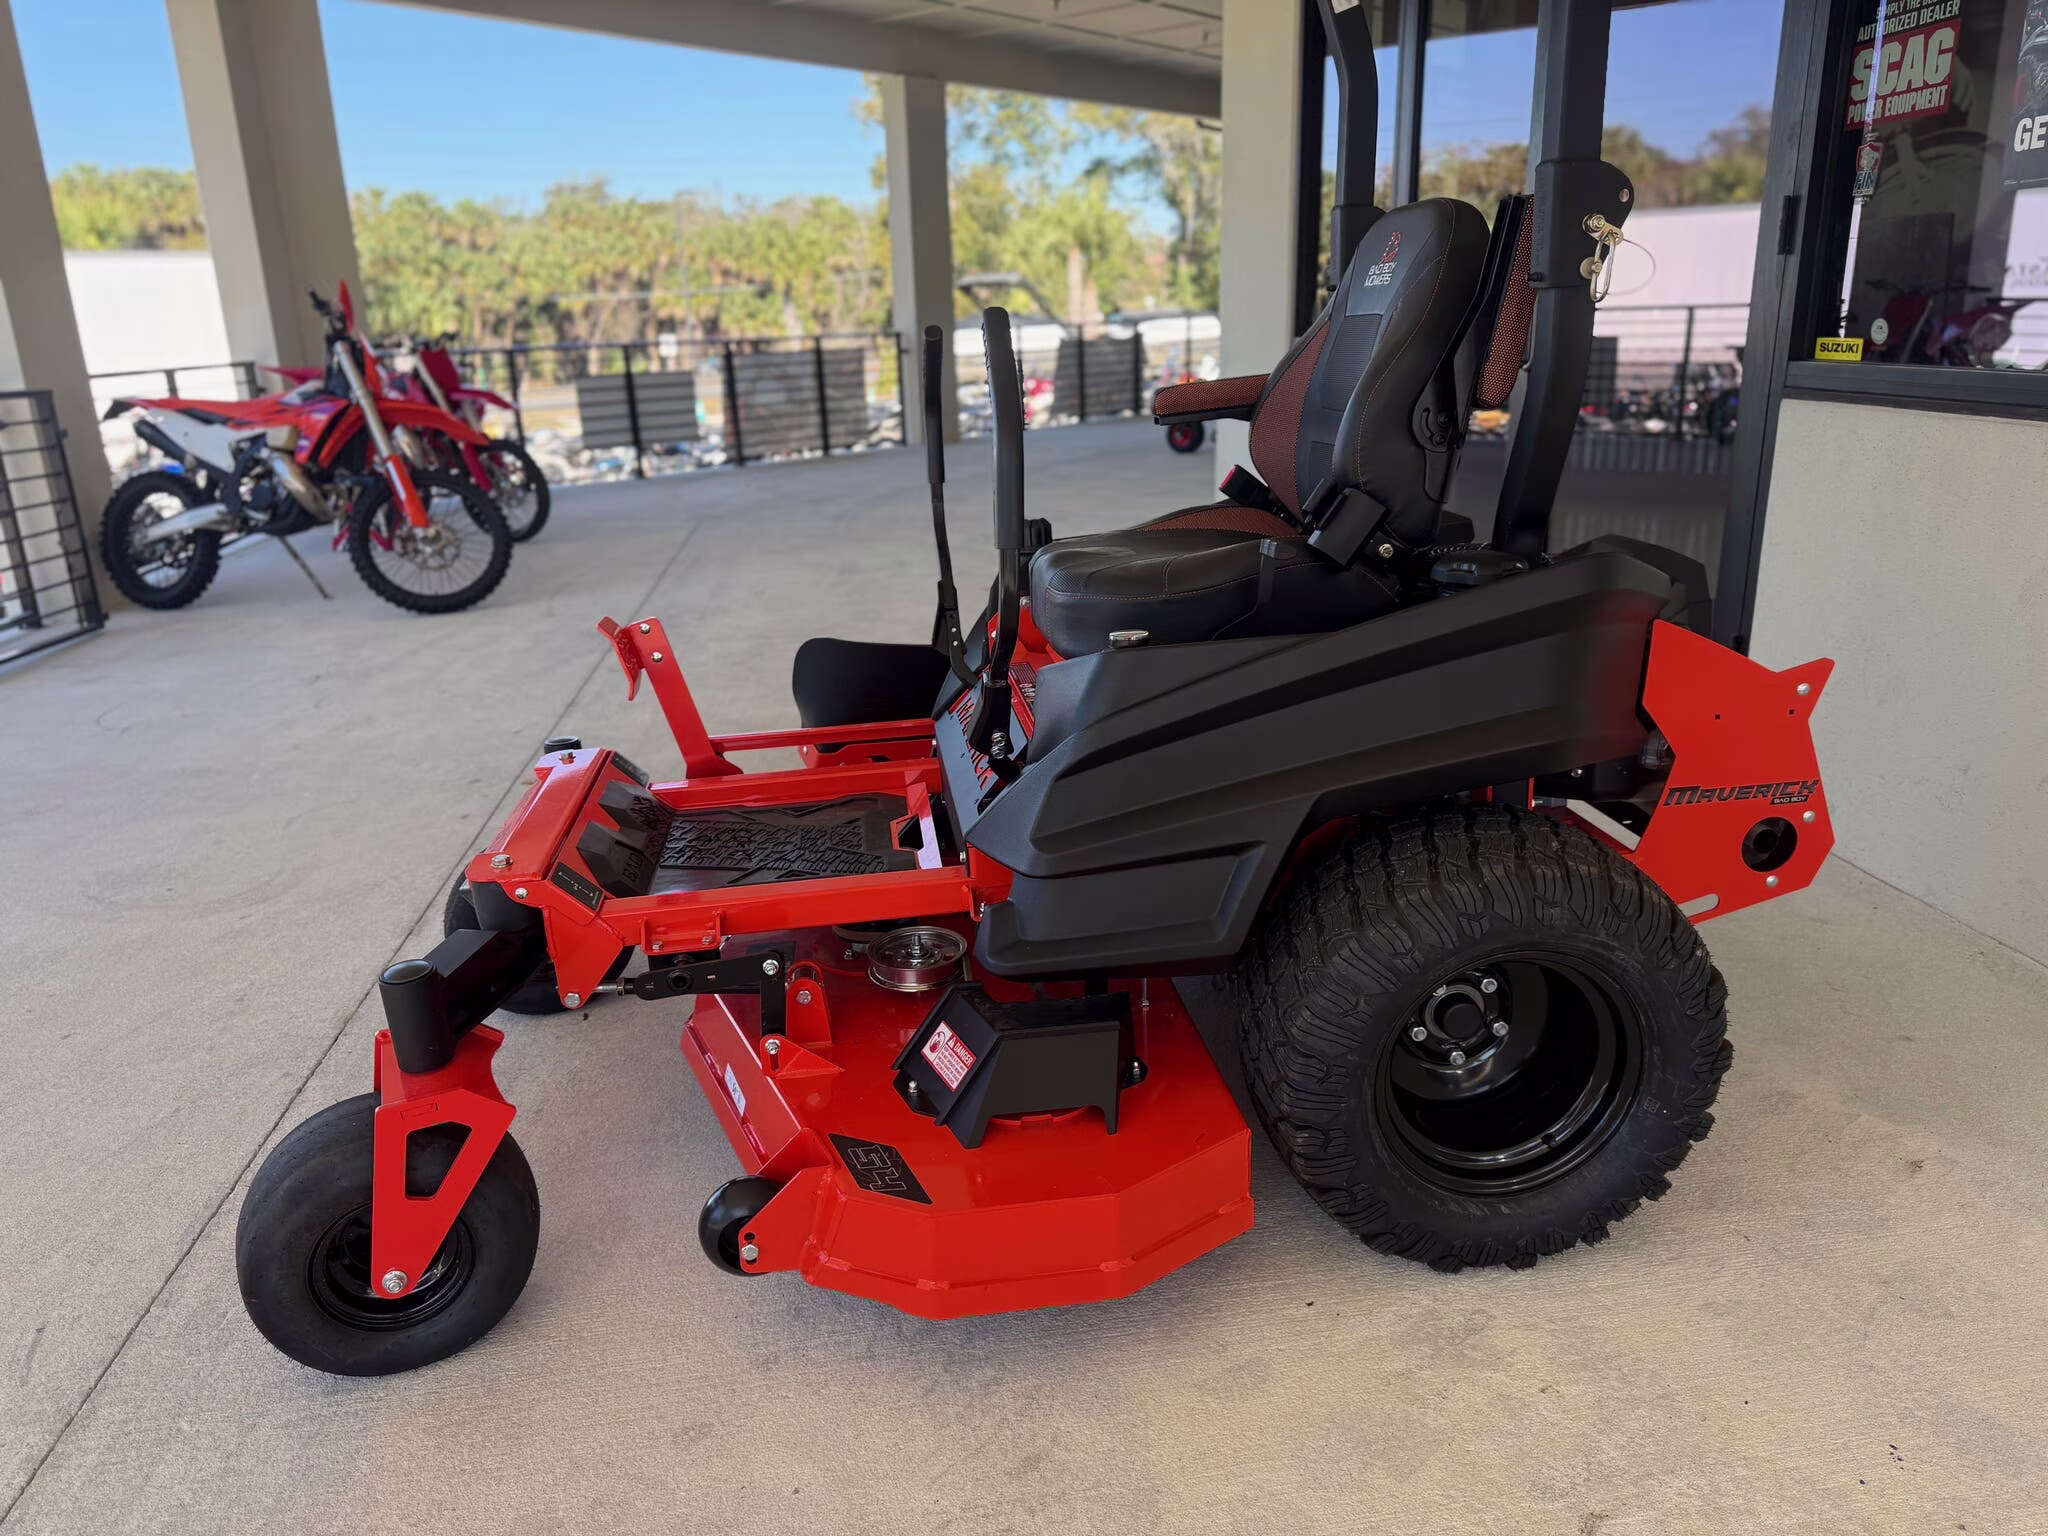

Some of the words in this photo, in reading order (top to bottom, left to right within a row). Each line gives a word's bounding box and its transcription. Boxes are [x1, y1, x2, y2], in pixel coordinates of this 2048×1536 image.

[1856, 11, 1919, 42] AUTORIZED
[1919, 0, 1961, 25] DEALER
[1850, 27, 1956, 102] SCAG
[1884, 85, 1948, 117] EQUIPMENT
[1818, 342, 1860, 355] SUZUKI
[1663, 779, 1820, 807] MAVERICK
[953, 1042, 975, 1068] DANGER
[847, 1144, 907, 1192] 54
